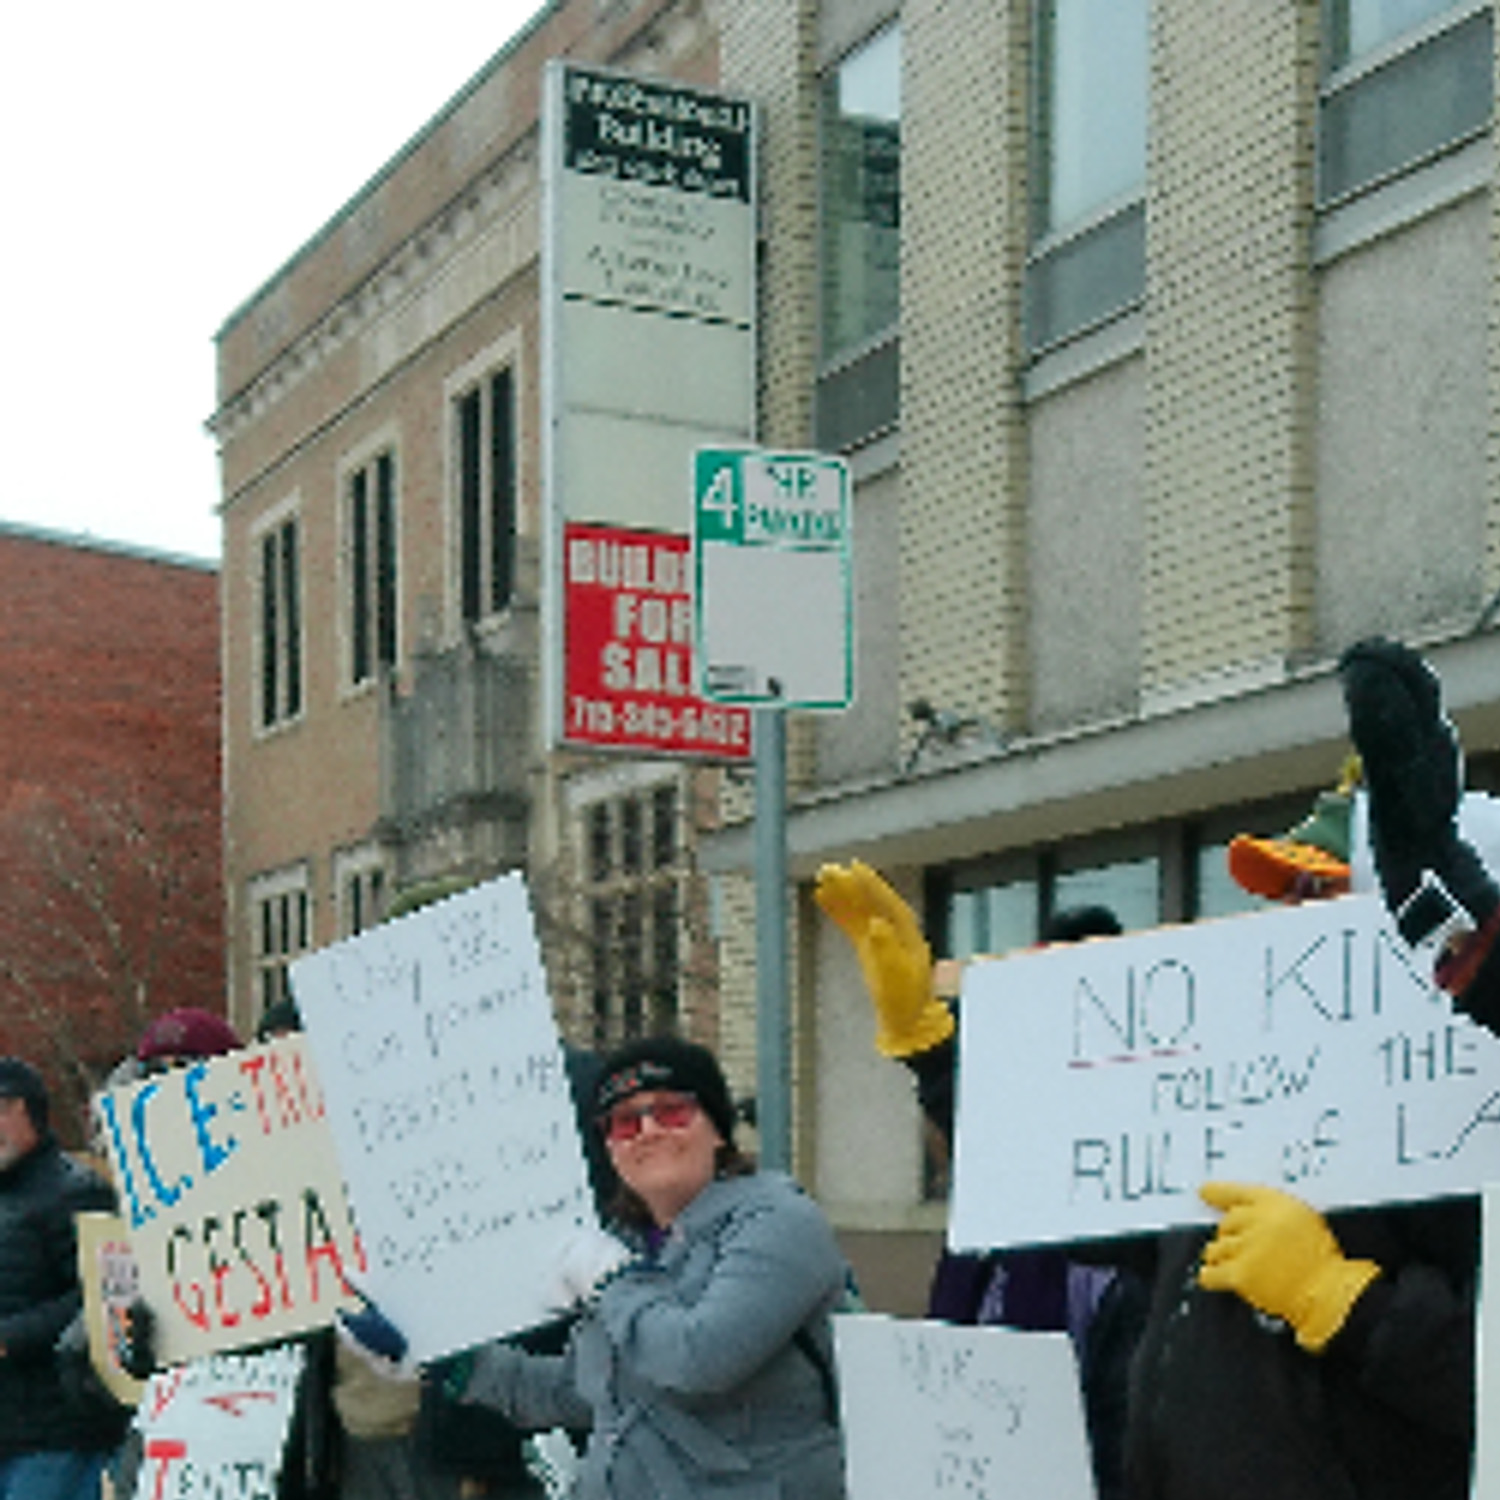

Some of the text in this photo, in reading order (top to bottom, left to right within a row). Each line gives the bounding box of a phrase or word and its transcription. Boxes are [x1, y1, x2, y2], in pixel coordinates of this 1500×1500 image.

[702, 465, 738, 529] 4
[615, 593, 692, 645] FOR
[602, 640, 692, 697] SAL
[1074, 957, 1196, 1056] NO
[1151, 1023, 1478, 1116] FOLLOW THE
[1069, 1120, 1244, 1204] RULE
